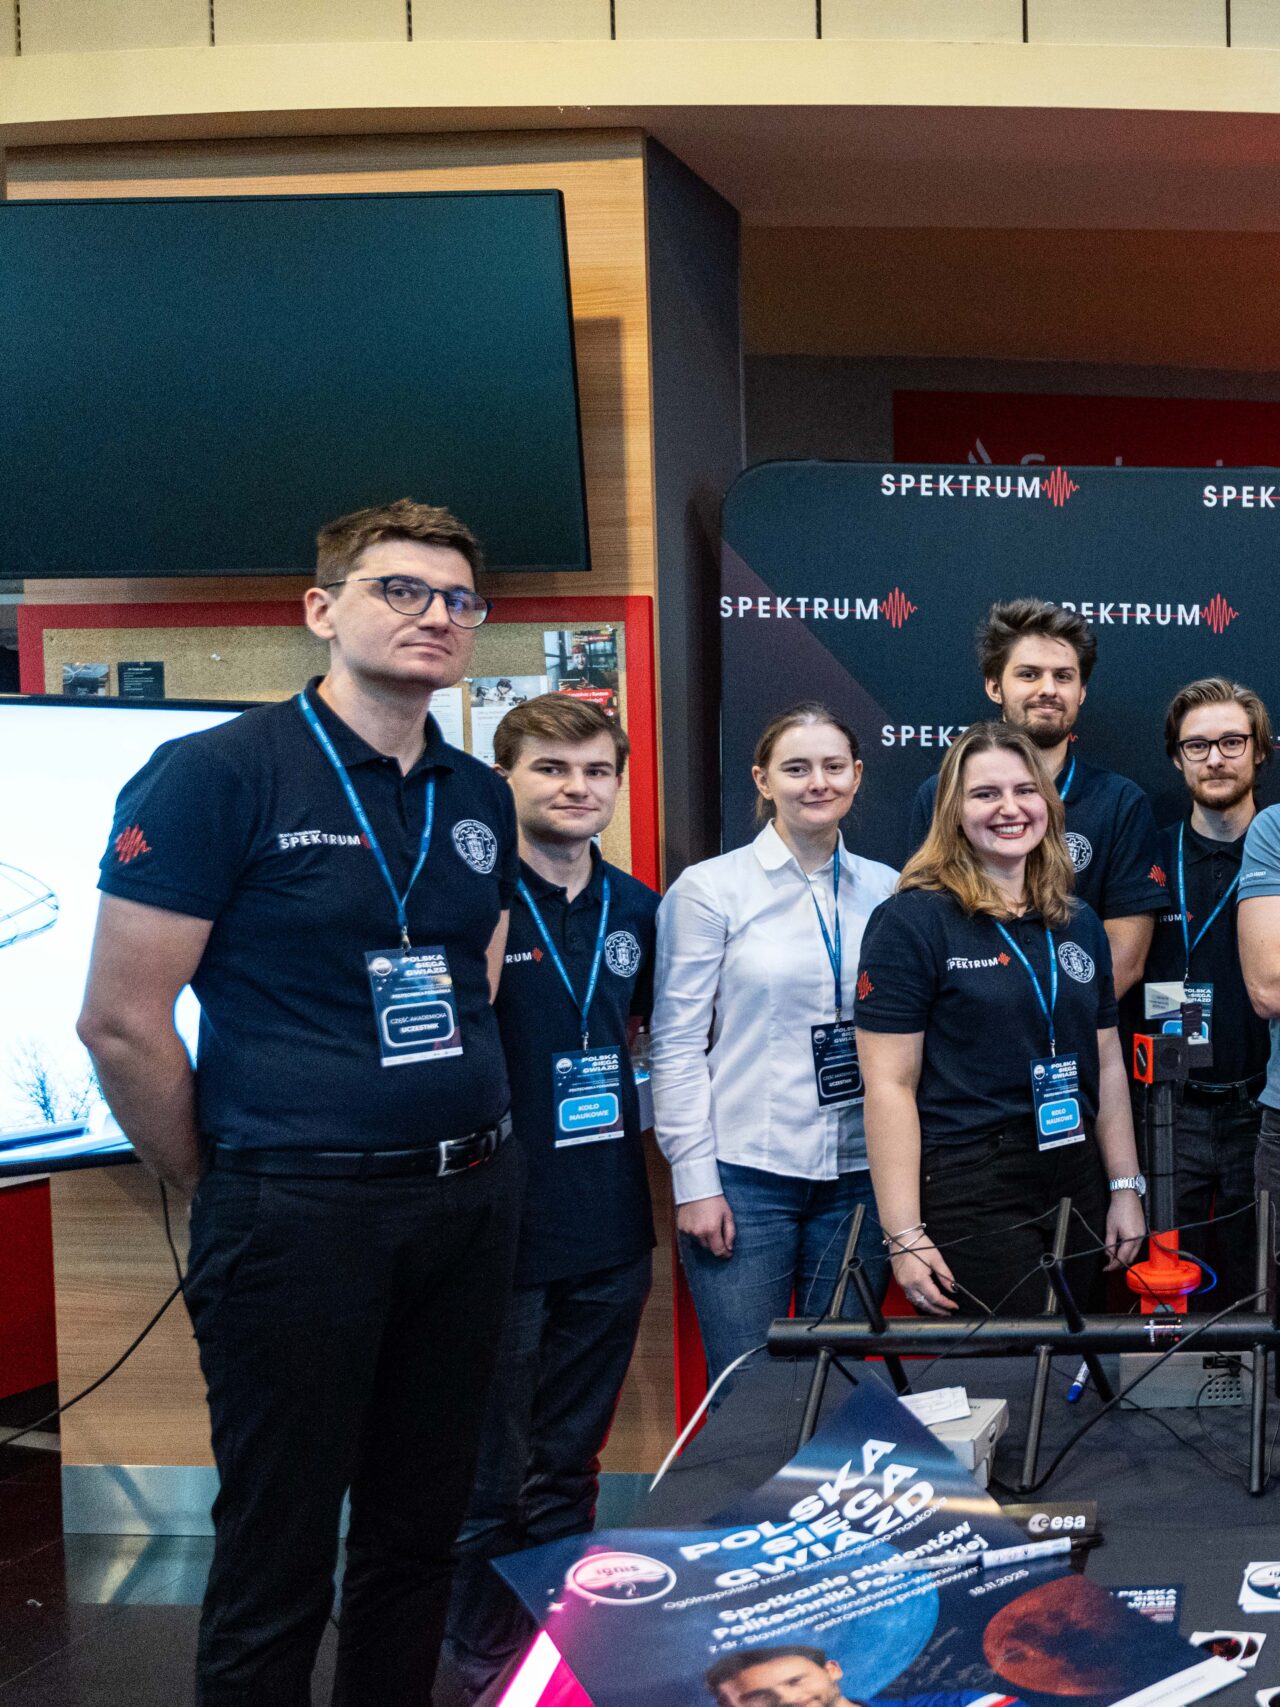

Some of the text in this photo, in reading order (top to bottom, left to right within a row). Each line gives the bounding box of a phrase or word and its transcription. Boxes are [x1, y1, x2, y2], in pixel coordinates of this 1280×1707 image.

[880, 472, 1041, 499] SPEKTRUM
[719, 595, 879, 620] SPEKTRUM
[280, 833, 361, 851] SPEKTRUM
[568, 1110, 609, 1121] NAUKOWE
[679, 1438, 897, 1562] POLSKA
[760, 1463, 919, 1556] SIĘGA
[714, 1480, 935, 1589] GWIAZD
[1049, 1515, 1086, 1531] esa
[596, 1565, 641, 1576] ignis
[718, 1520, 972, 1624] Spotkanie studentów
[1117, 1588, 1177, 1598] POLSKA
[712, 1587, 858, 1641] Politechniki
